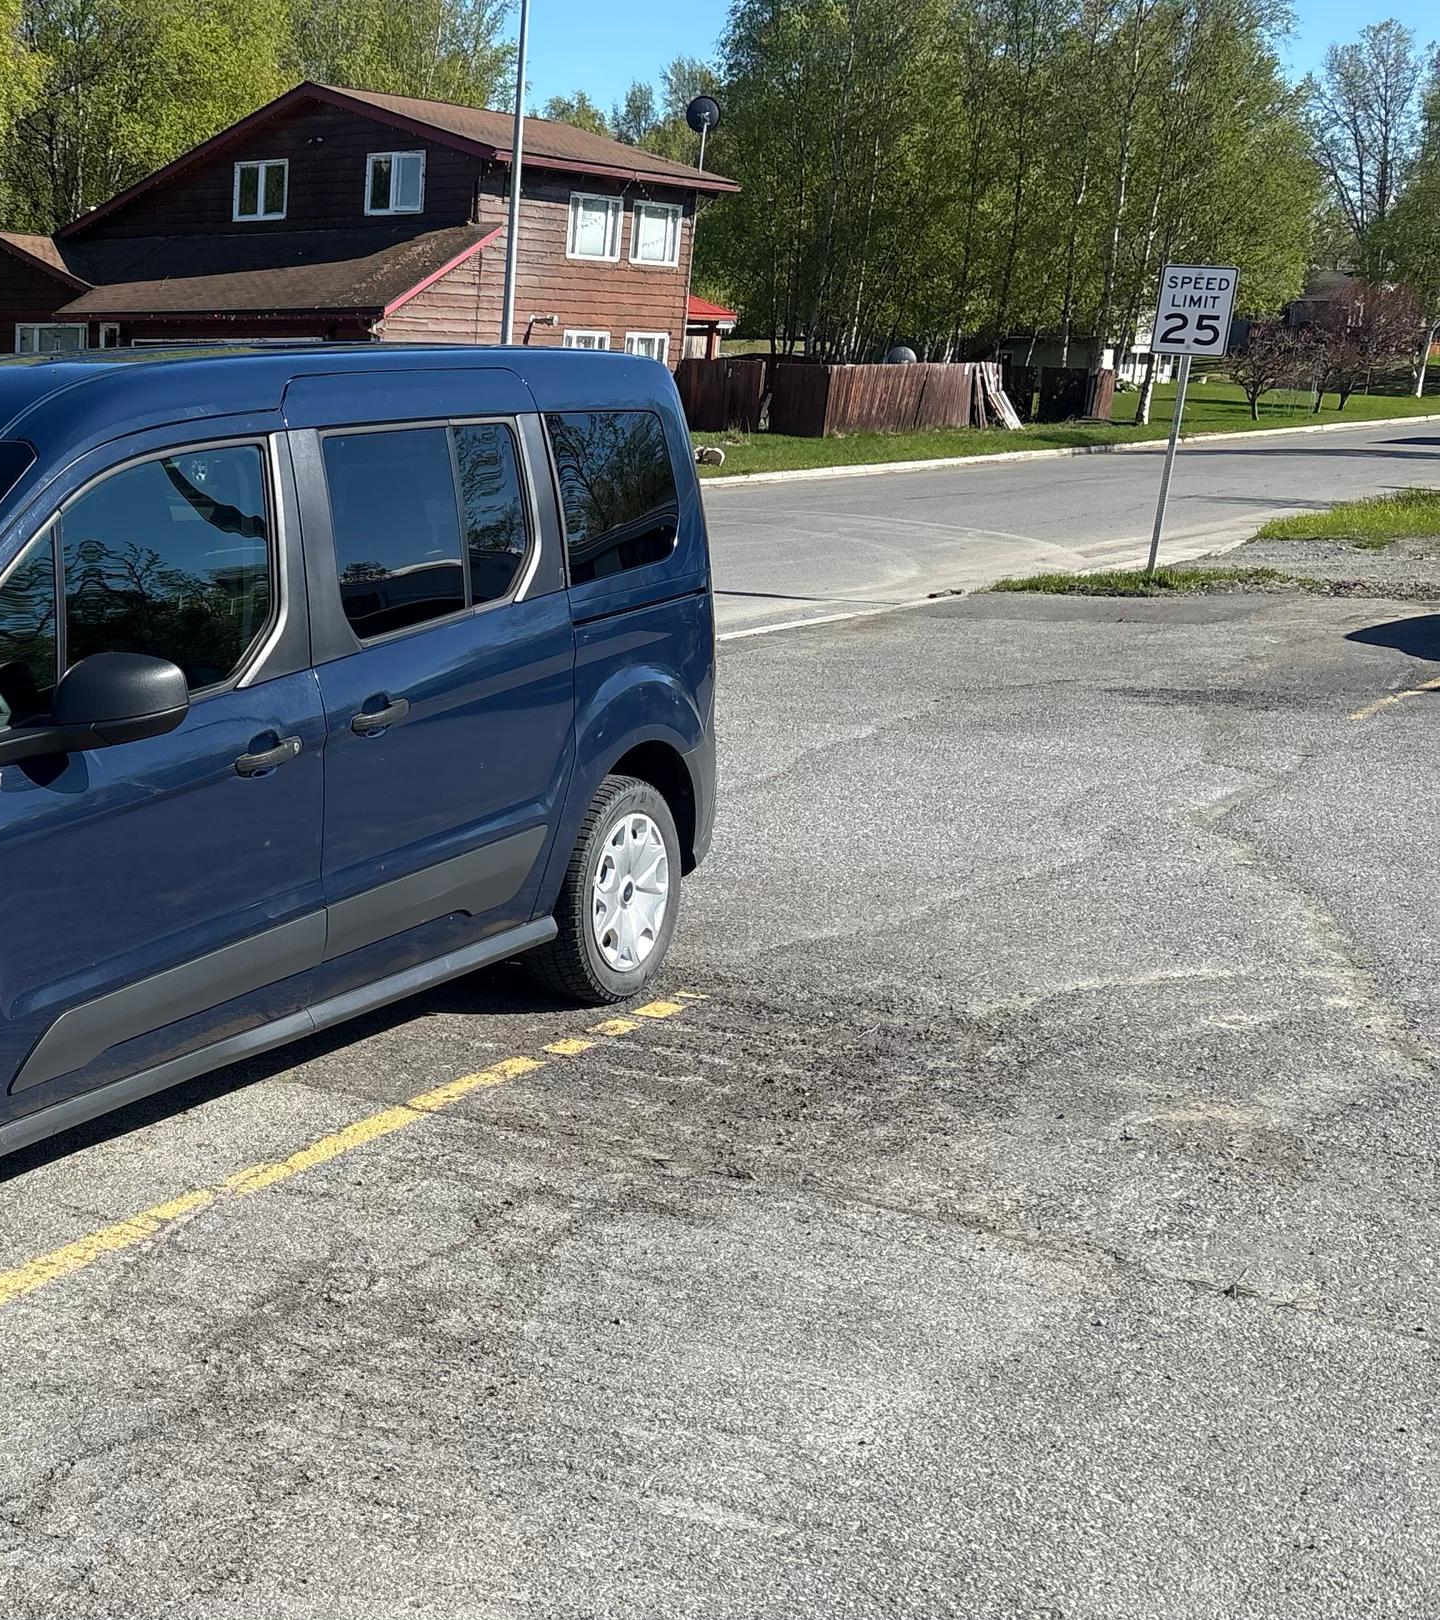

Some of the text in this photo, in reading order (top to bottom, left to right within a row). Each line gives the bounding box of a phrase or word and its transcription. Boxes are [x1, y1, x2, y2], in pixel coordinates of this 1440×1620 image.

[1167, 276, 1230, 291] SPEED
[1171, 294, 1220, 309] LIMIT
[1160, 313, 1220, 346] 25
